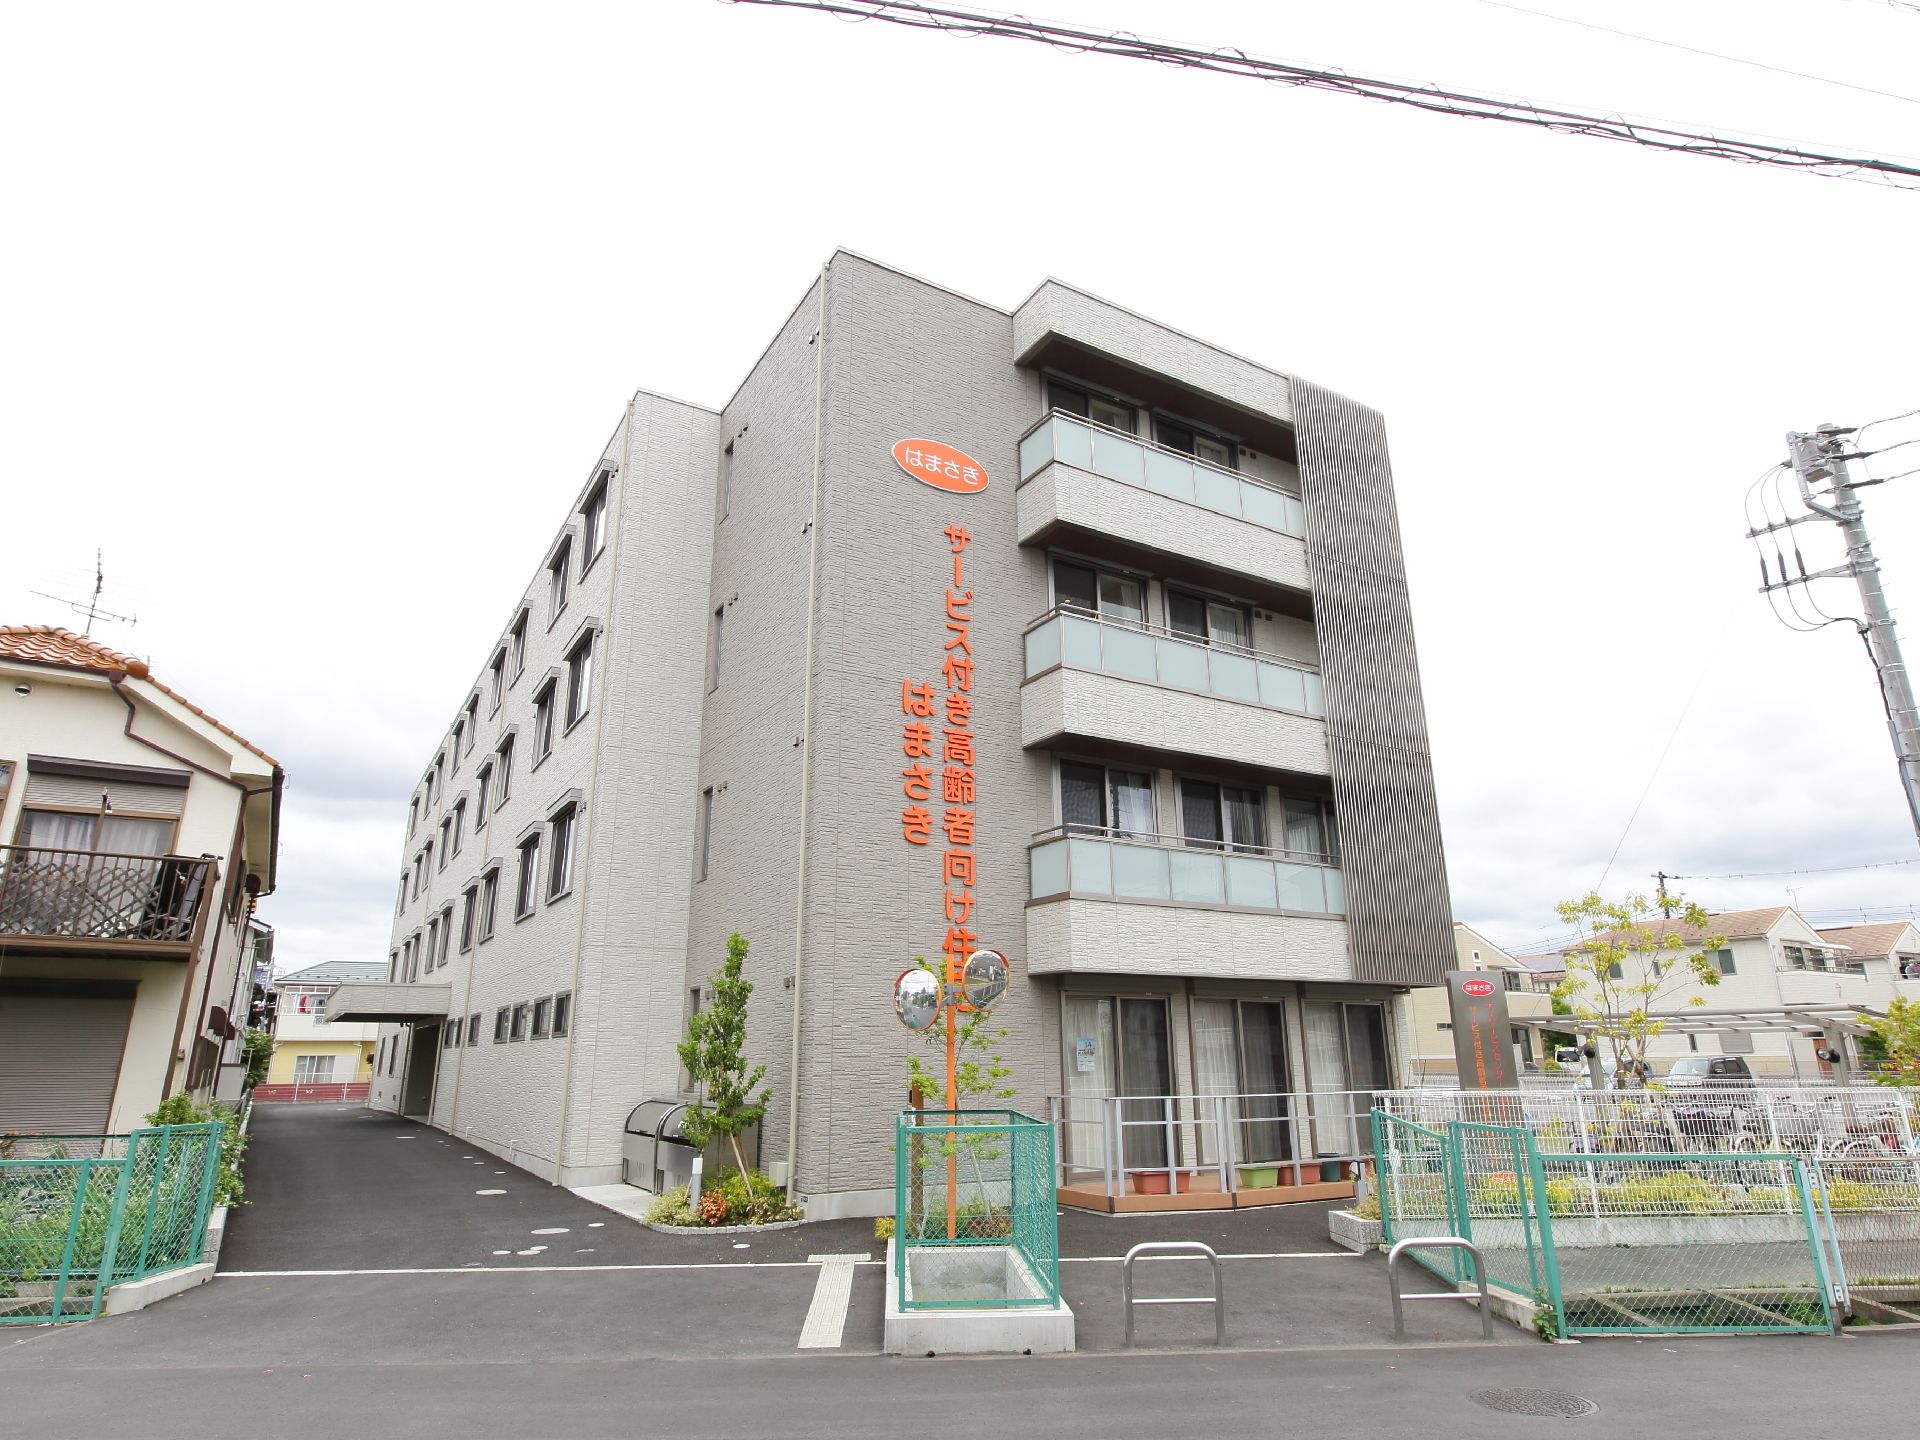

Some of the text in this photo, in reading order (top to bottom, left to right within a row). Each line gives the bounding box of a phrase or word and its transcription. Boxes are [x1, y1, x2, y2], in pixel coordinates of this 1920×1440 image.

[905, 445, 980, 486] はまさき
[902, 678, 936, 845] はまさき
[942, 522, 977, 1012] サービス付き高齢者向け住
[1465, 984, 1492, 992] はまさき
